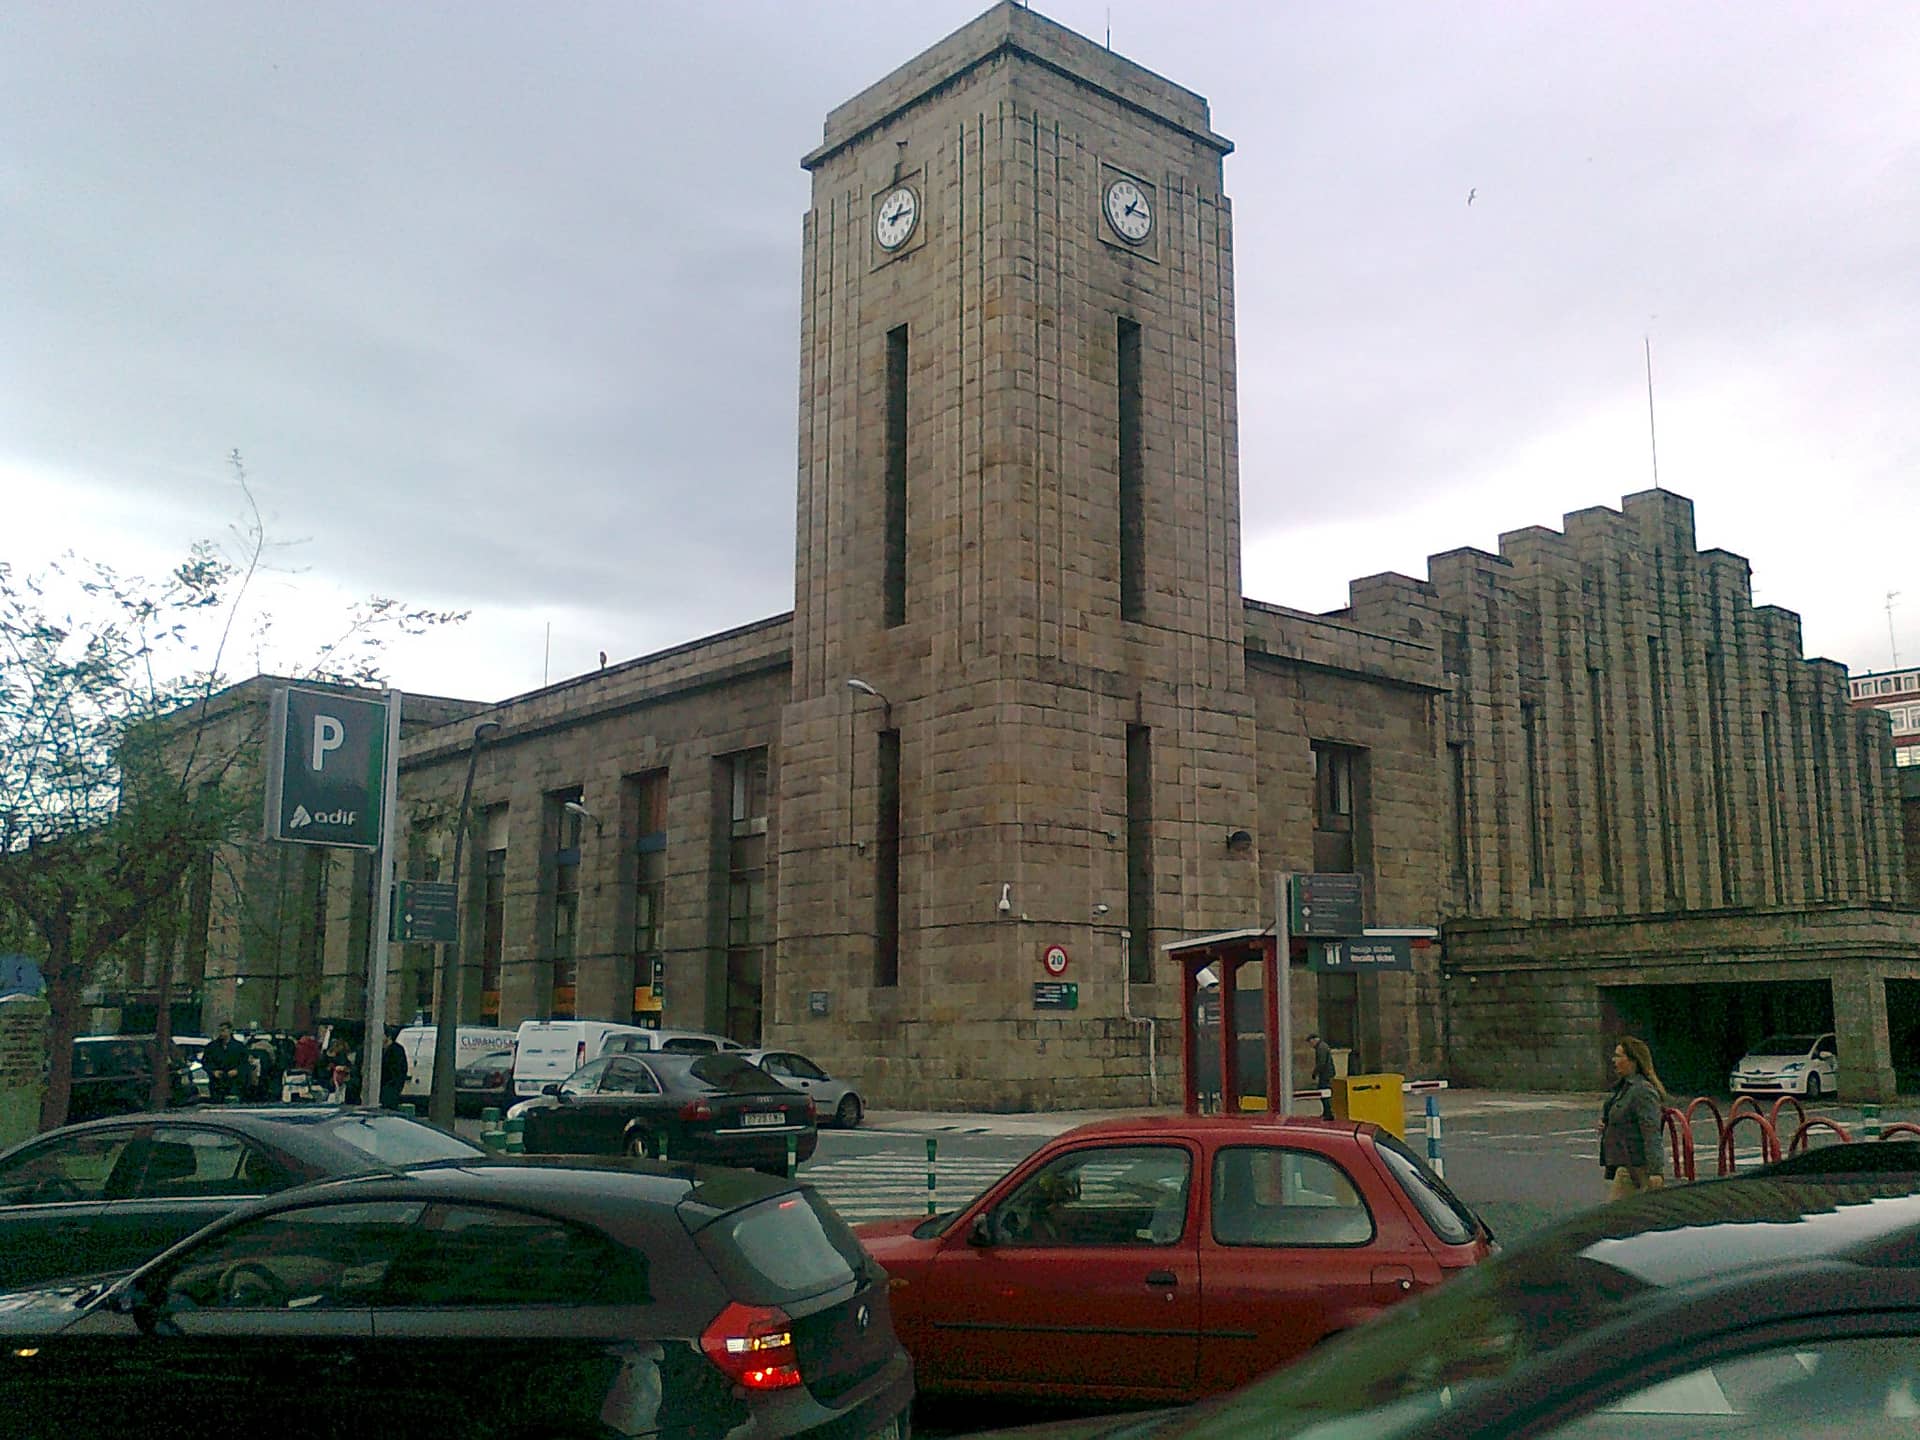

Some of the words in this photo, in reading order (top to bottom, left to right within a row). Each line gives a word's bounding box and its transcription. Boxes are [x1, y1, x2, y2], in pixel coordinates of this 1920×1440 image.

[312, 714, 344, 771] P
[314, 808, 357, 827] adif
[1050, 954, 1063, 966] 20
